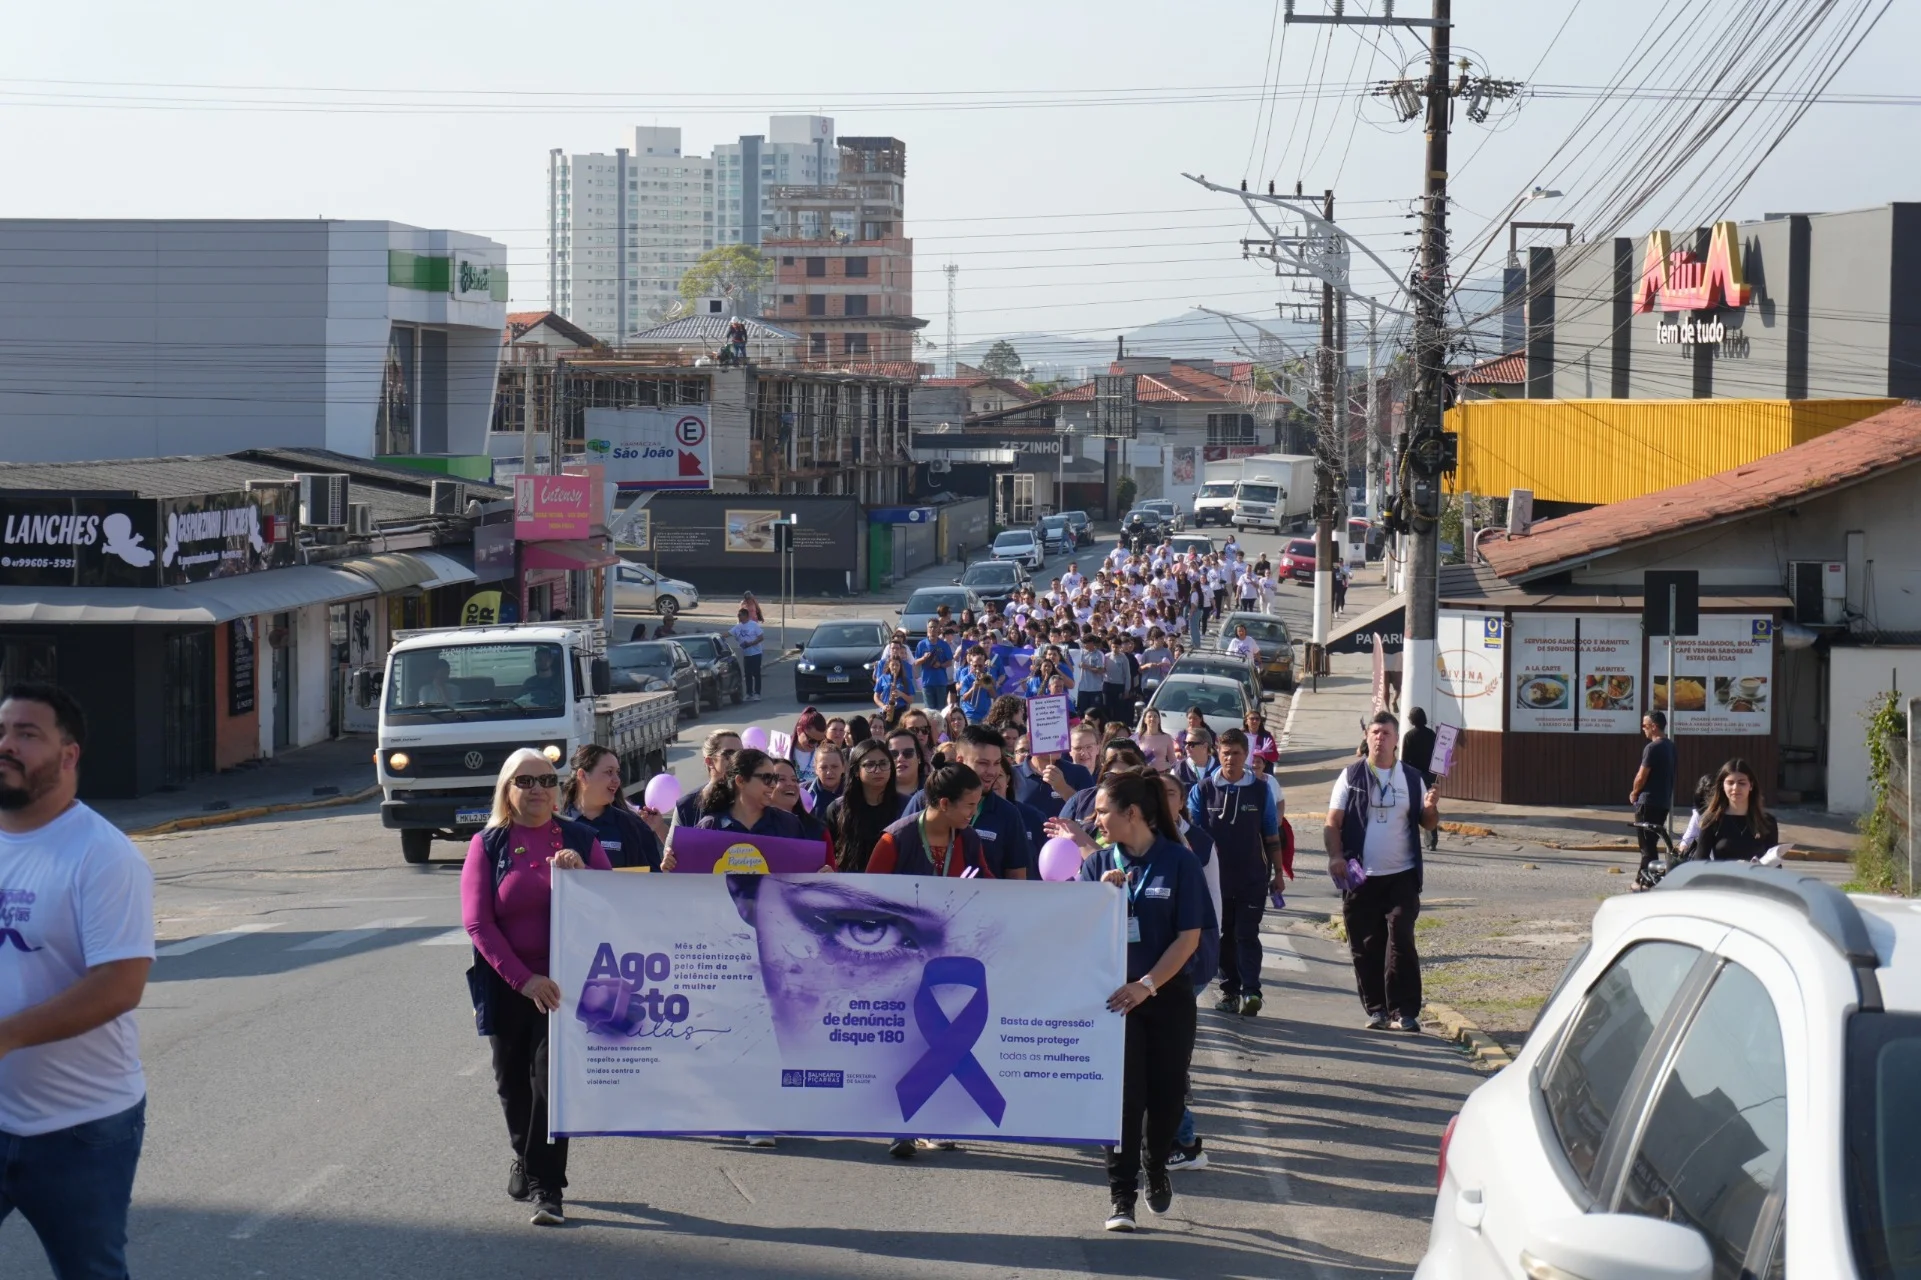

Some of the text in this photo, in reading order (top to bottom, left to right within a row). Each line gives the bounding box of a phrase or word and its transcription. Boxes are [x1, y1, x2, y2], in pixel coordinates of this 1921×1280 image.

[1656, 315, 1724, 344] tem de tudo
[684, 422, 697, 440] E
[613, 446, 674, 459] São João
[1001, 441, 1060, 454] ZEZINHO
[4, 514, 99, 545] LANCHES
[1356, 633, 1404, 645] PAARI
[675, 942, 708, 950] Mês de
[674, 952, 752, 963] conscientização
[587, 943, 671, 992] Ago
[674, 962, 728, 972] pelo fim da
[674, 972, 719, 981] violência
[682, 983, 717, 991] mulher
[849, 1000, 906, 1011] em caso
[823, 1012, 905, 1028] de denúncia
[1000, 1017, 1094, 1029] Basta de agressão!
[829, 1028, 905, 1046] disque 180
[1000, 1034, 1079, 1047] Vamos proteger
[586, 1056, 615, 1065] respeito
[1000, 1052, 1027, 1060] todas
[1043, 1053, 1090, 1063] mulheres
[999, 1070, 1020, 1078] com
[1023, 1070, 1050, 1079] amor
